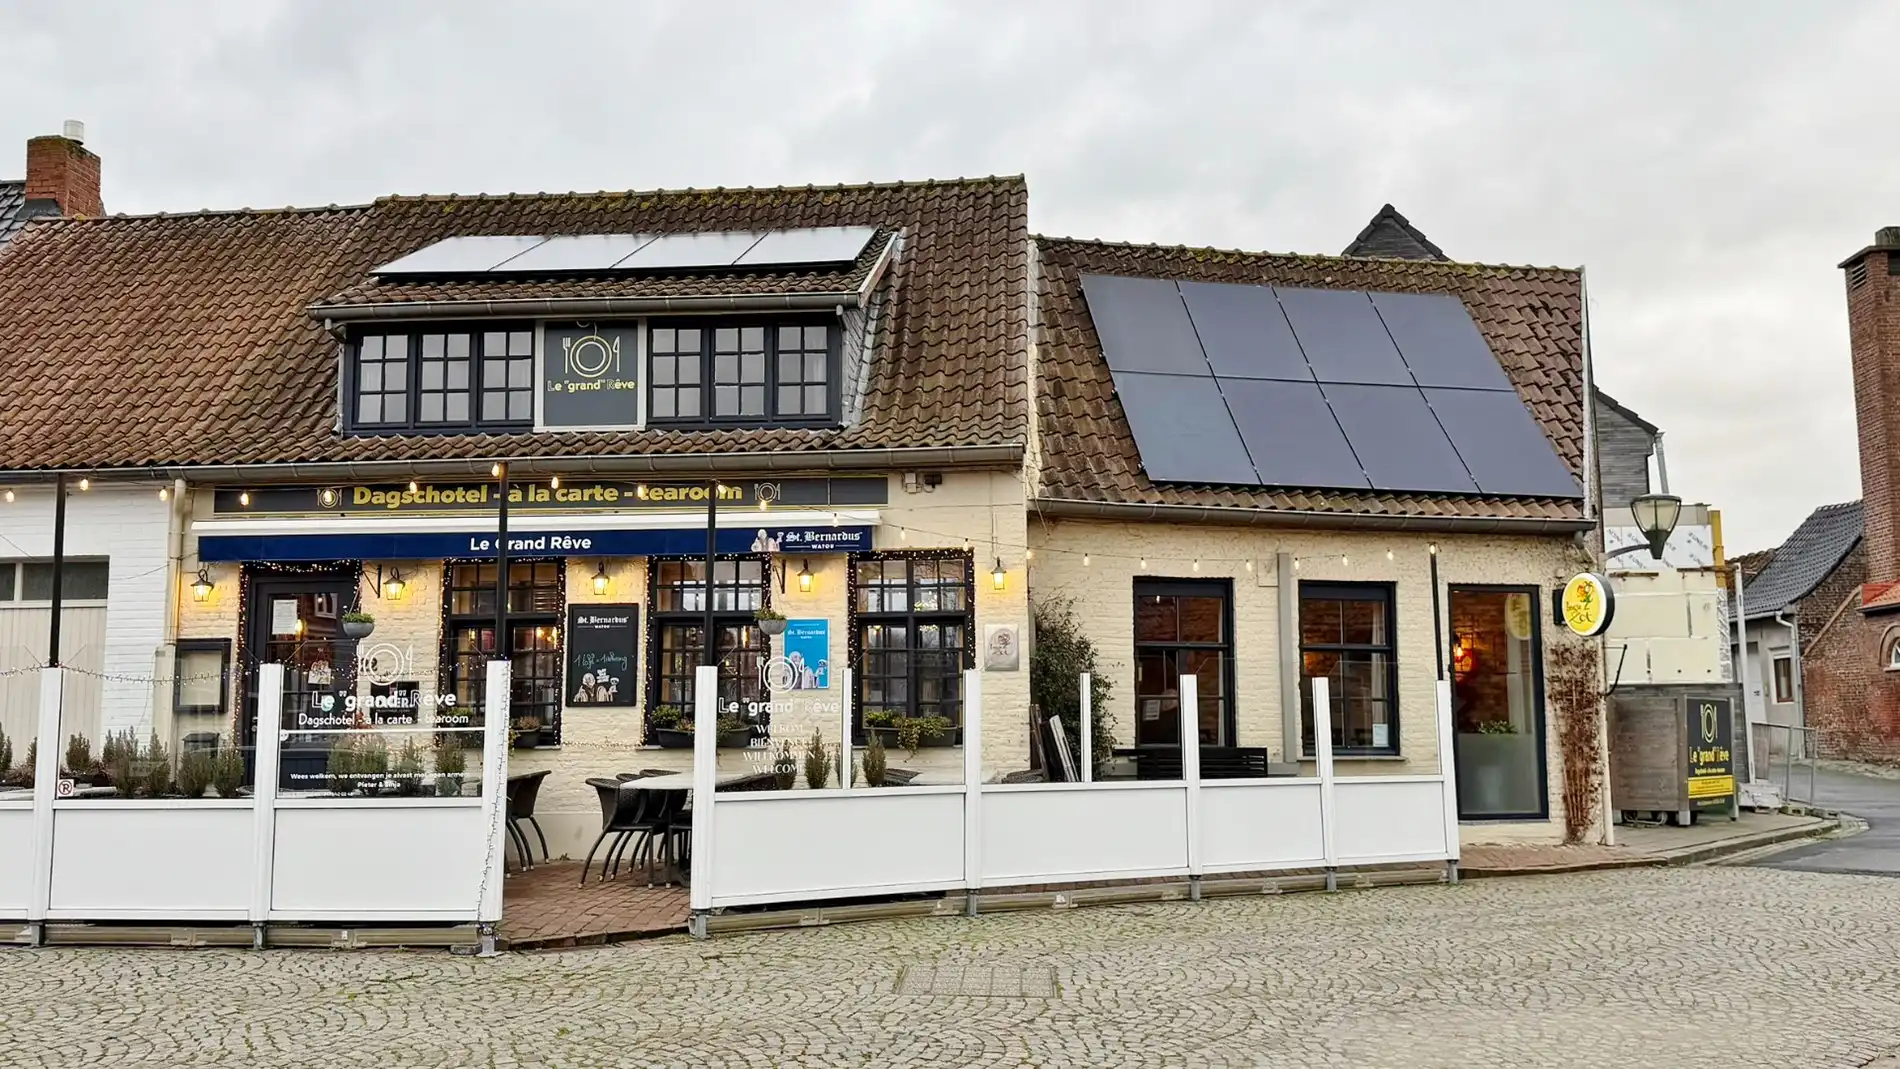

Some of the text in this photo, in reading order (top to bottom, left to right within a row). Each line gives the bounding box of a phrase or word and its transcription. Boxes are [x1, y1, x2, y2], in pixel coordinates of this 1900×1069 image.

[547, 380, 562, 392] Le
[606, 378, 635, 390] Rêve
[353, 485, 488, 509] Dagschotel
[507, 484, 523, 502] à
[528, 484, 550, 502] la
[555, 485, 619, 502] carte
[470, 536, 592, 551] Le rand Rêve
[786, 531, 863, 543] St. Bernardus
[311, 691, 336, 710] Le
[718, 697, 740, 714] Le
[298, 712, 355, 727] Dagschotel
[374, 712, 384, 725] la
[386, 713, 412, 725] carte
